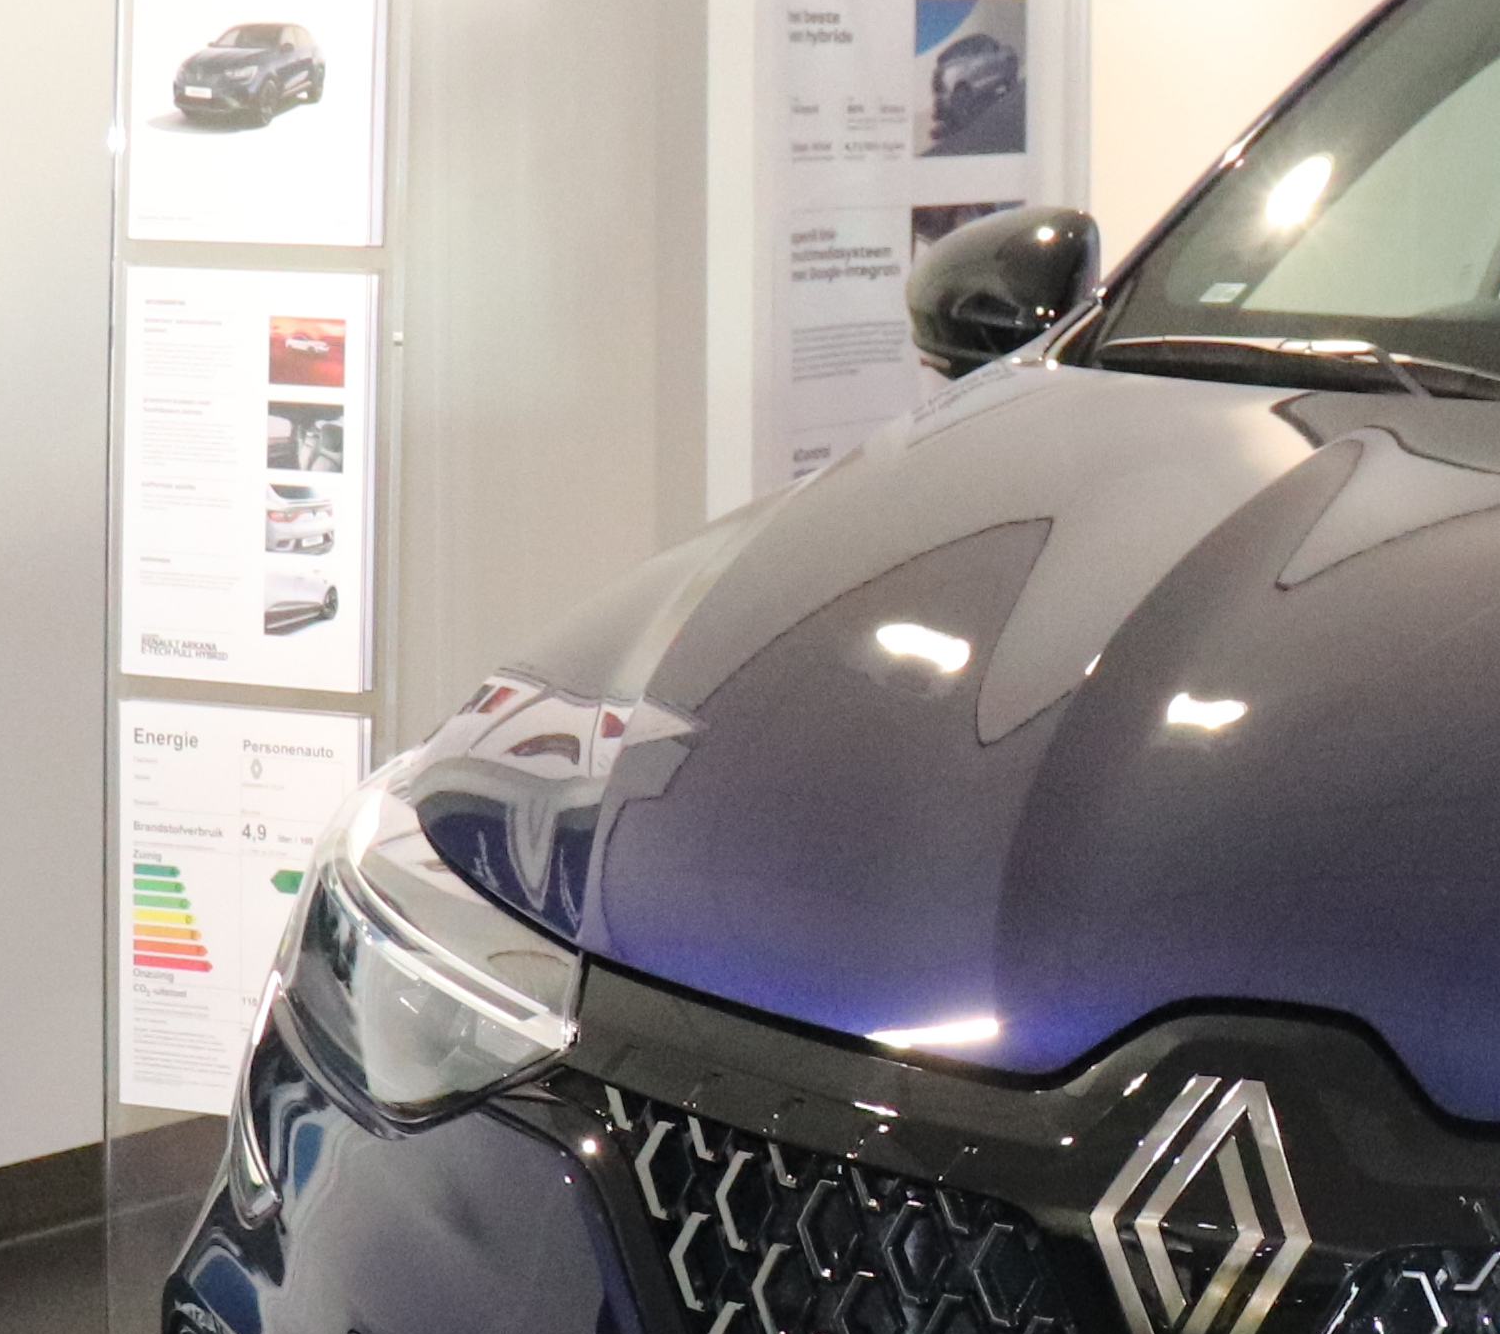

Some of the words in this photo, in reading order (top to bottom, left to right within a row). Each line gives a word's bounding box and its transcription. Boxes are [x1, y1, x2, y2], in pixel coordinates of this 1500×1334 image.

[133, 727, 199, 752] Energie
[243, 739, 334, 759] Personenauto
[133, 820, 224, 839] Brandstofverbruik
[241, 822, 267, 843] 4,9
